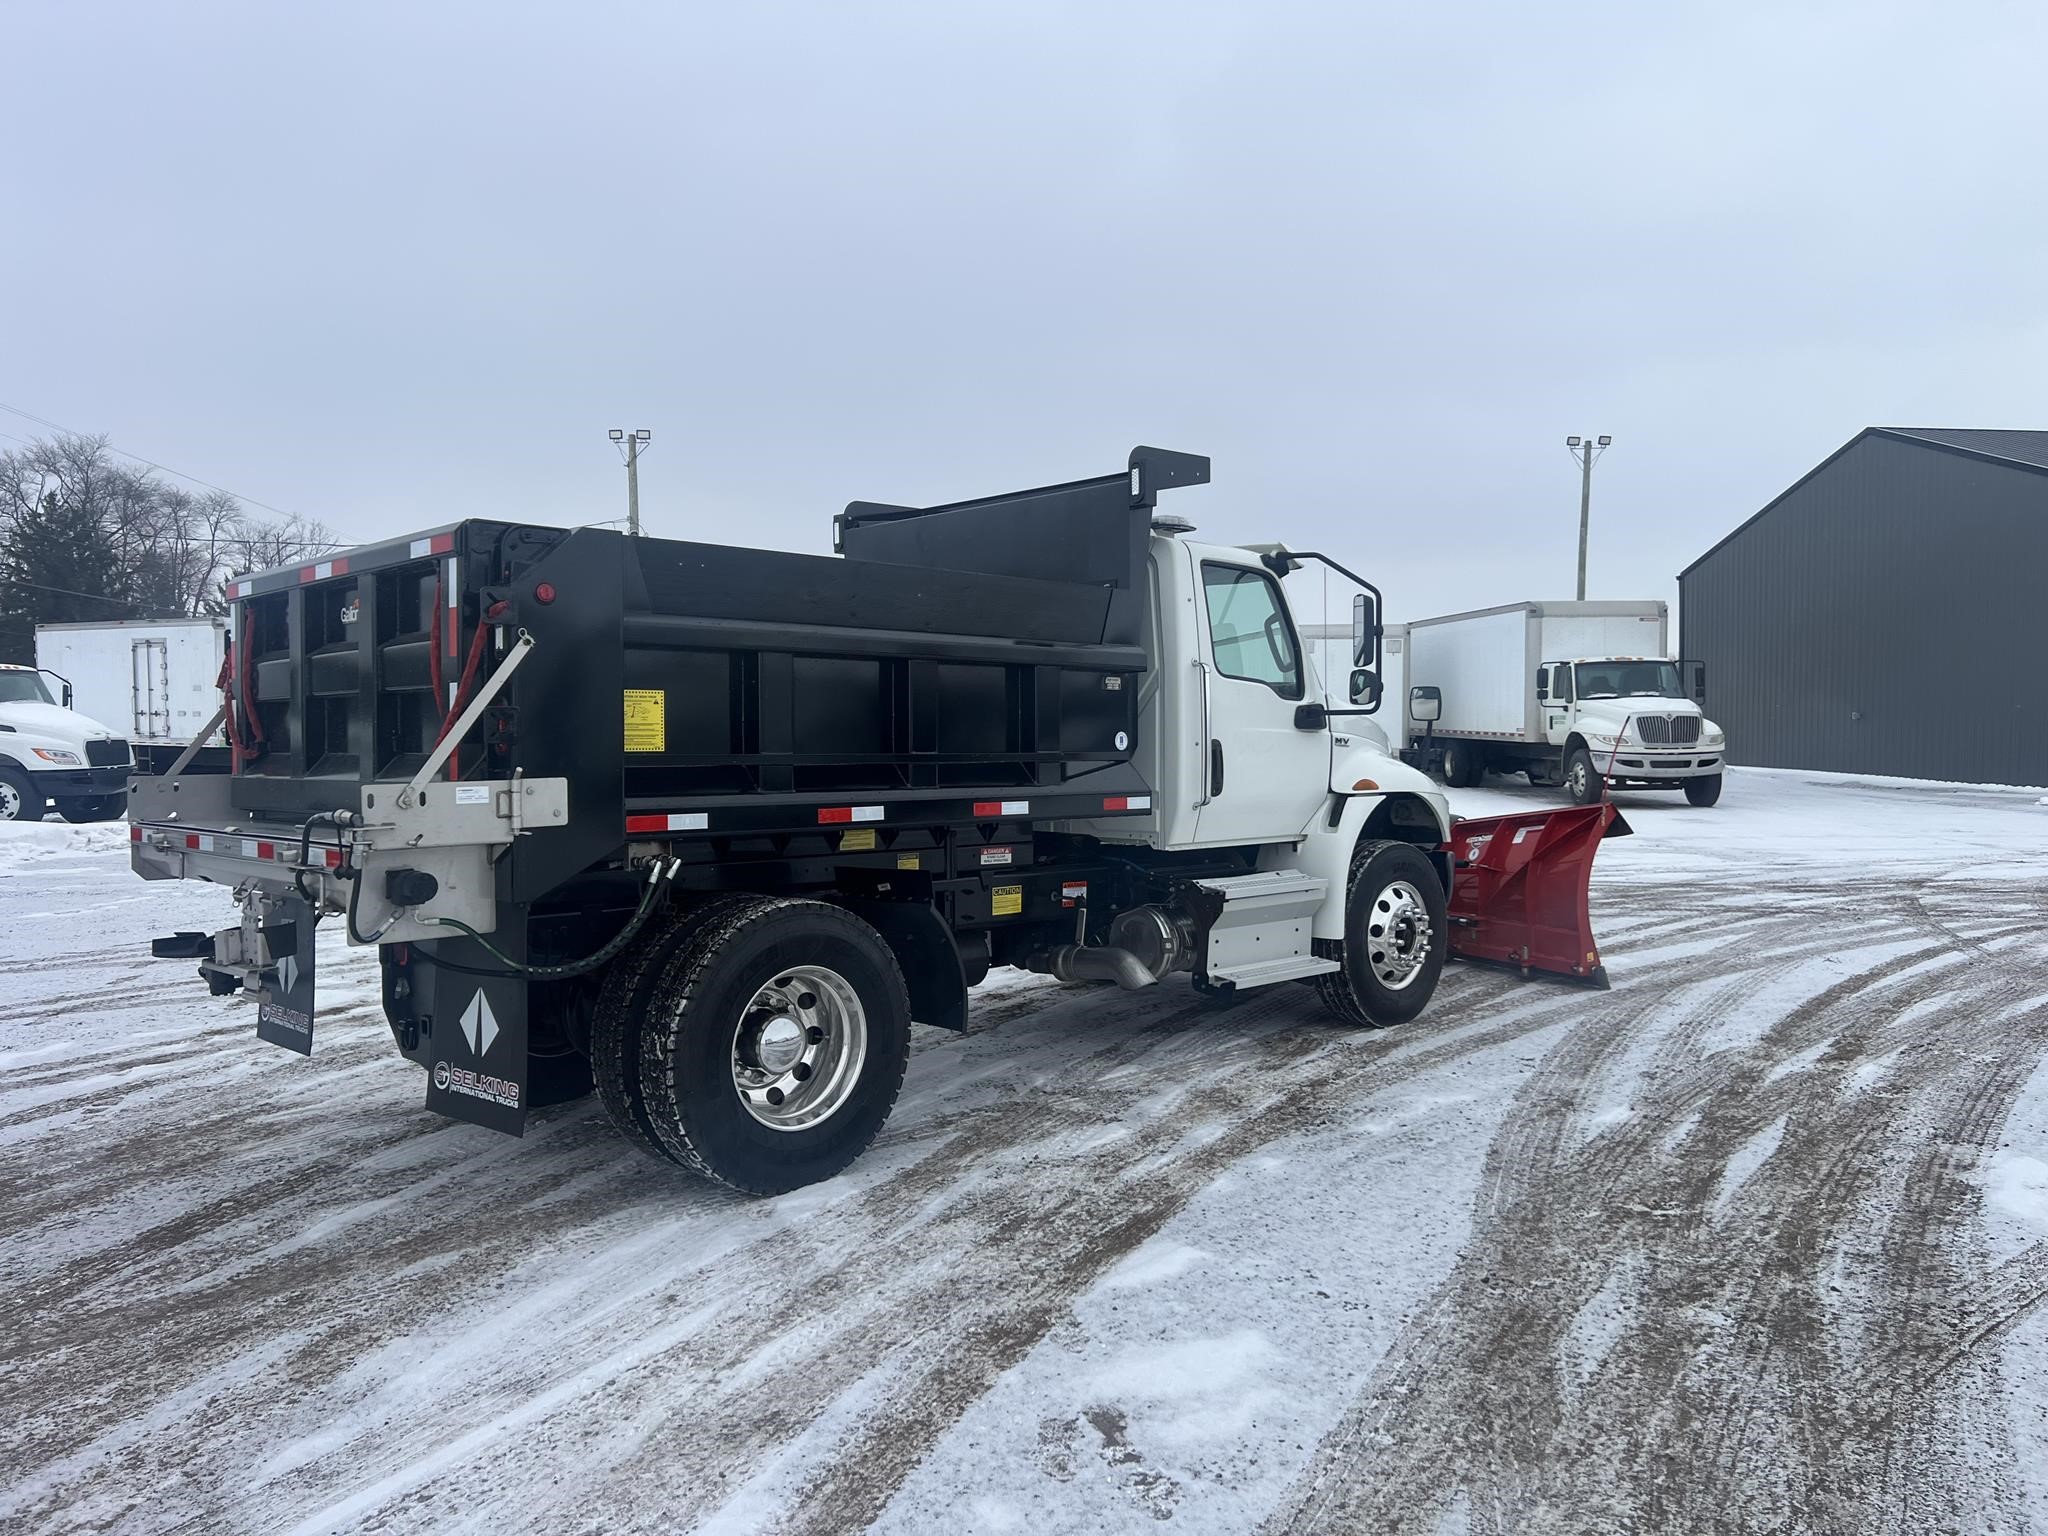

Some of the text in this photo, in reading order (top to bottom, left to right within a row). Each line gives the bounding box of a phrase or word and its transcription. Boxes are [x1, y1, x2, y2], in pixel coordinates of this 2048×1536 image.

[993, 887, 1020, 896] CAUTION
[270, 1003, 309, 1028] SELKING
[451, 1067, 519, 1100] SELKING
[451, 1083, 519, 1109] INTERNATIONAL TRUCKS
